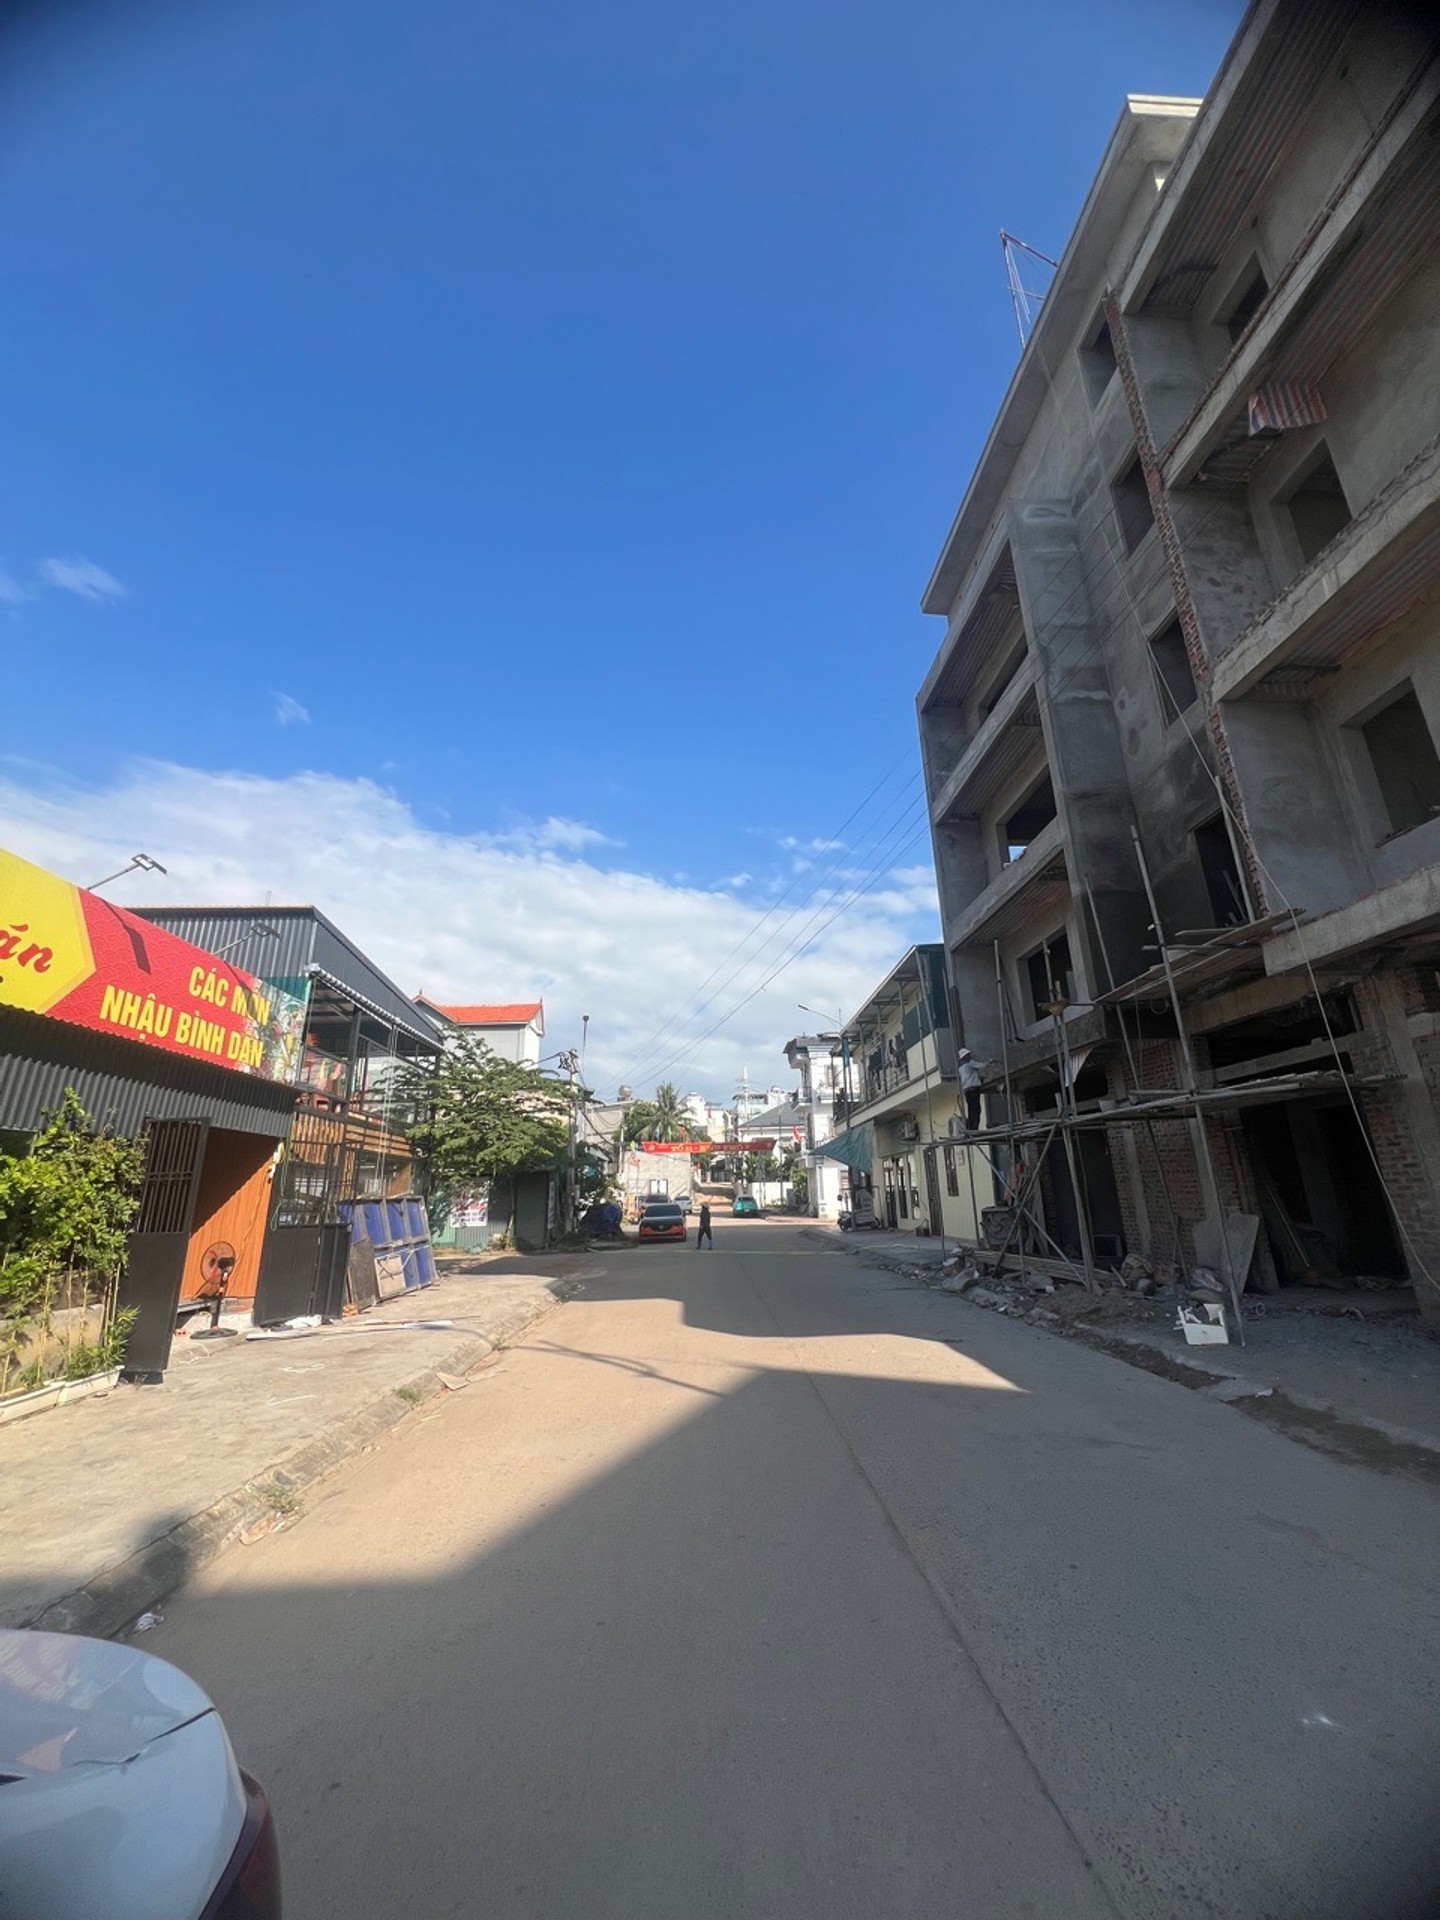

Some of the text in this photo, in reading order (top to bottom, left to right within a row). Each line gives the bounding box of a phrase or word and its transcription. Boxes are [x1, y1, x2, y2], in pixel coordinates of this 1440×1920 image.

[189, 966, 229, 1008] CÁC
[99, 984, 264, 1068] NHẬU BÌNH DÂN
